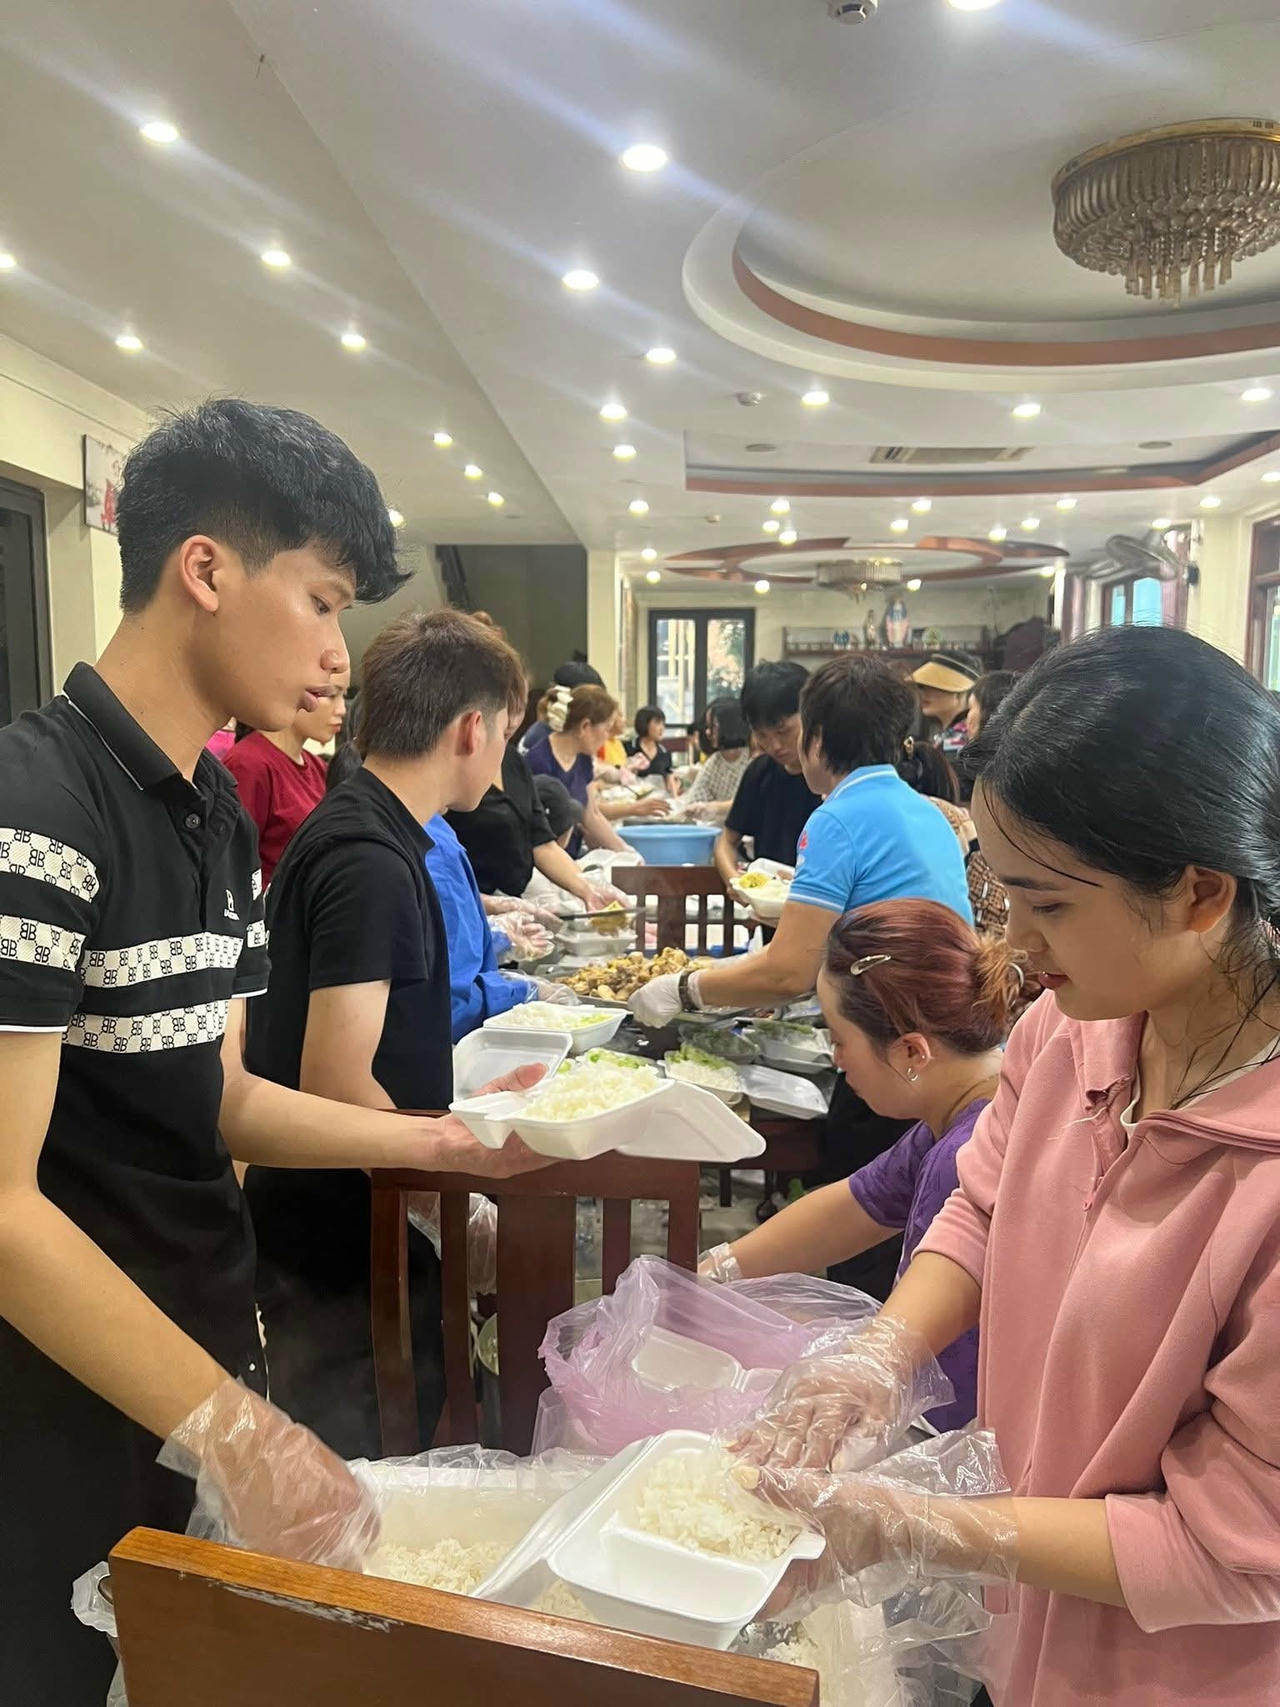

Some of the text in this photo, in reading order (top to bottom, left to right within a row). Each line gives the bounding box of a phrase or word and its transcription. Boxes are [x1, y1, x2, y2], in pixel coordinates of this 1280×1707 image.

[20, 922, 37, 940] BB
[34, 946, 51, 963] BB
[89, 951, 105, 967] BB
[102, 1018, 117, 1034] BB
[83, 1032, 99, 1047] BB
[113, 1036, 128, 1051] BB
